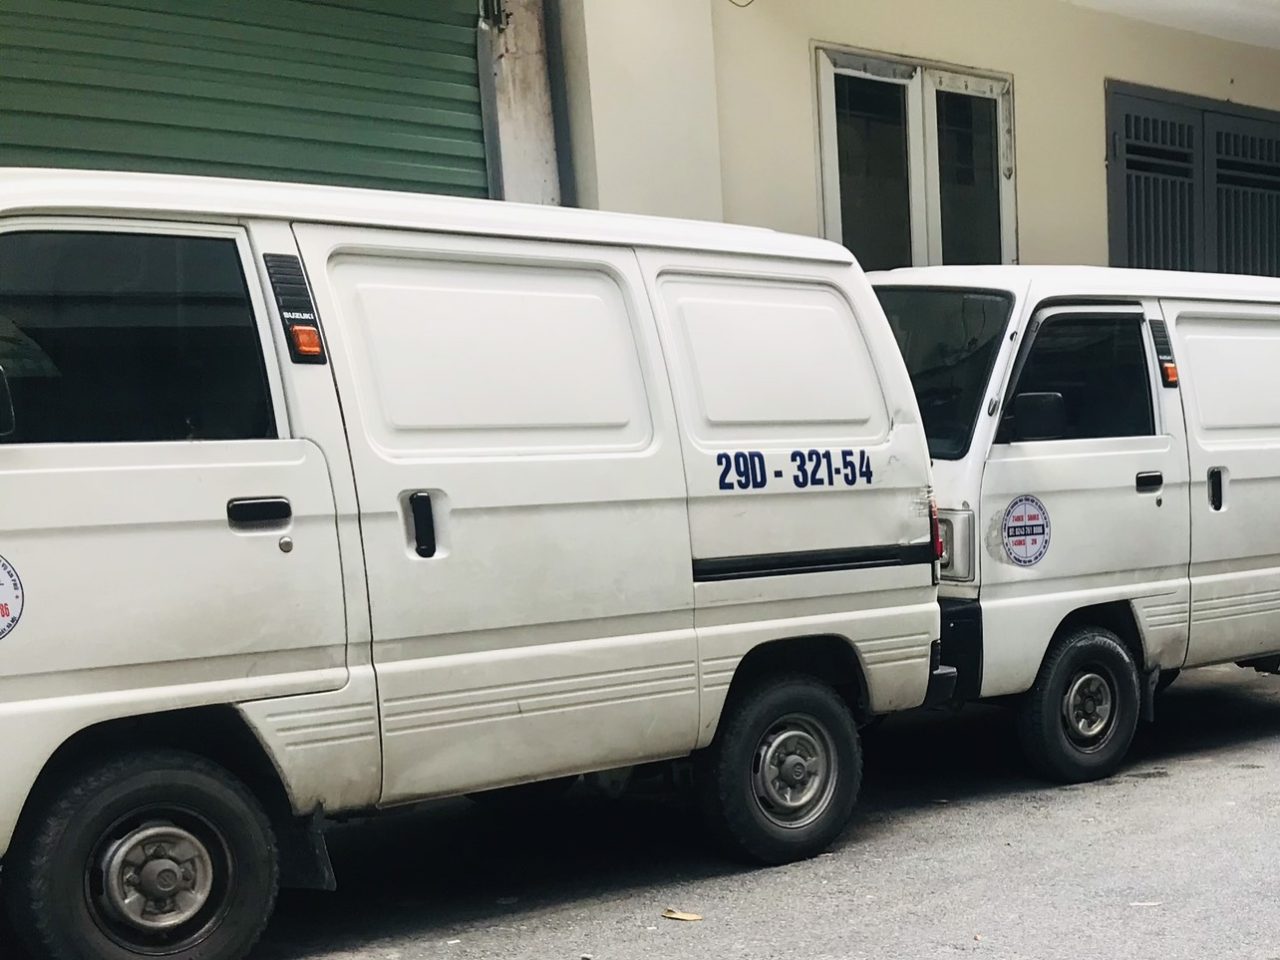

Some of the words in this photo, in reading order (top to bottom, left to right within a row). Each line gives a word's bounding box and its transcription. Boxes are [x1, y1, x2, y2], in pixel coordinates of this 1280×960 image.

[283, 311, 314, 320] SUZUKI
[716, 450, 767, 491] 29D
[790, 449, 873, 489] 321-54
